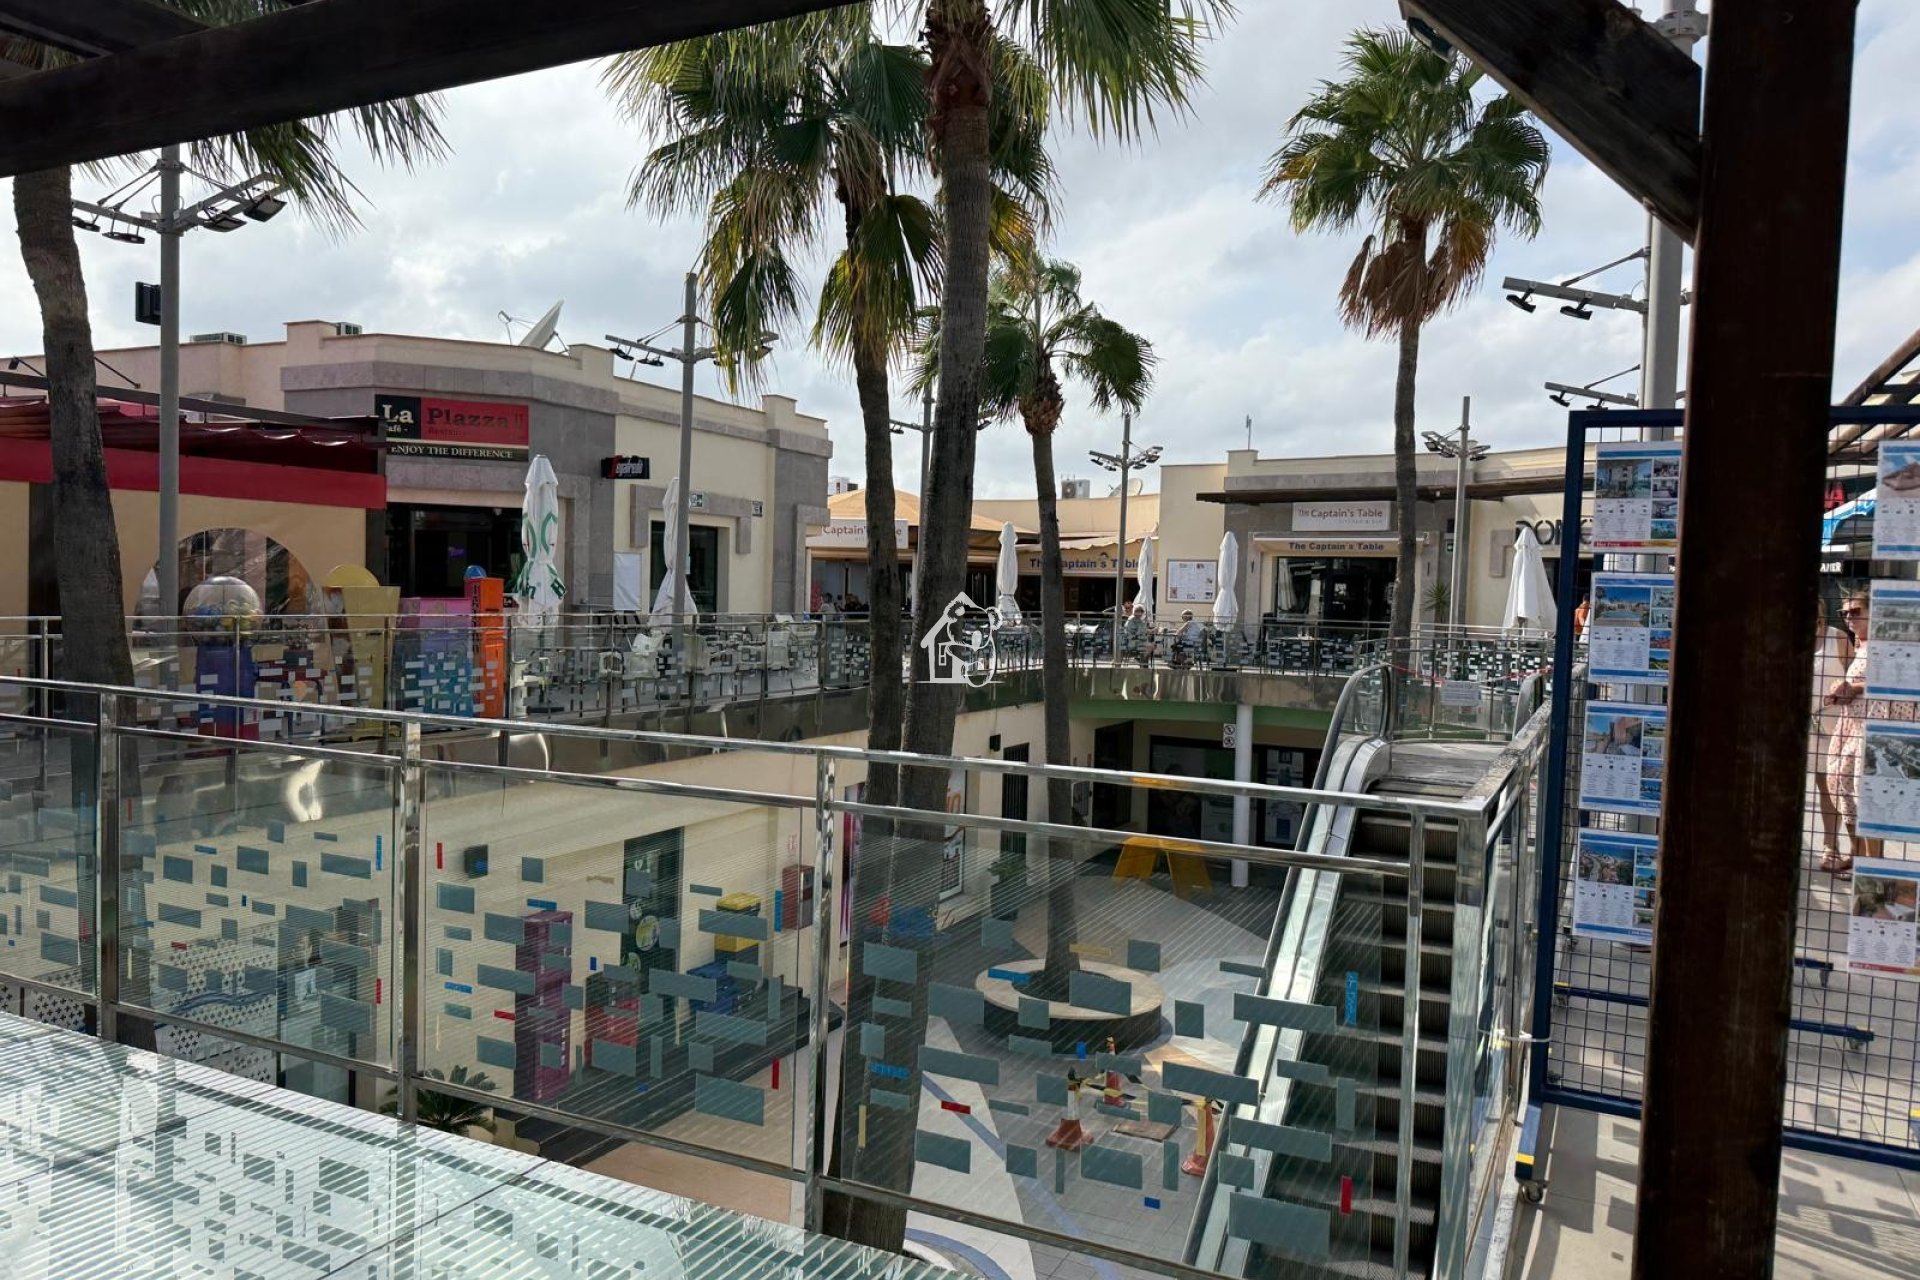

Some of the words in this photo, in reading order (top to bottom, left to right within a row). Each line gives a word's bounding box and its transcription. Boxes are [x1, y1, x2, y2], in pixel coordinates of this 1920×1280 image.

[382, 403, 414, 424] La
[426, 406, 509, 428] Plazza
[429, 446, 449, 456] THE
[451, 447, 514, 459] DIFFERENCE
[1311, 507, 1354, 520] Captain's
[1358, 507, 1383, 518] Table
[1288, 542, 1306, 551] The
[1357, 542, 1384, 551] Table
